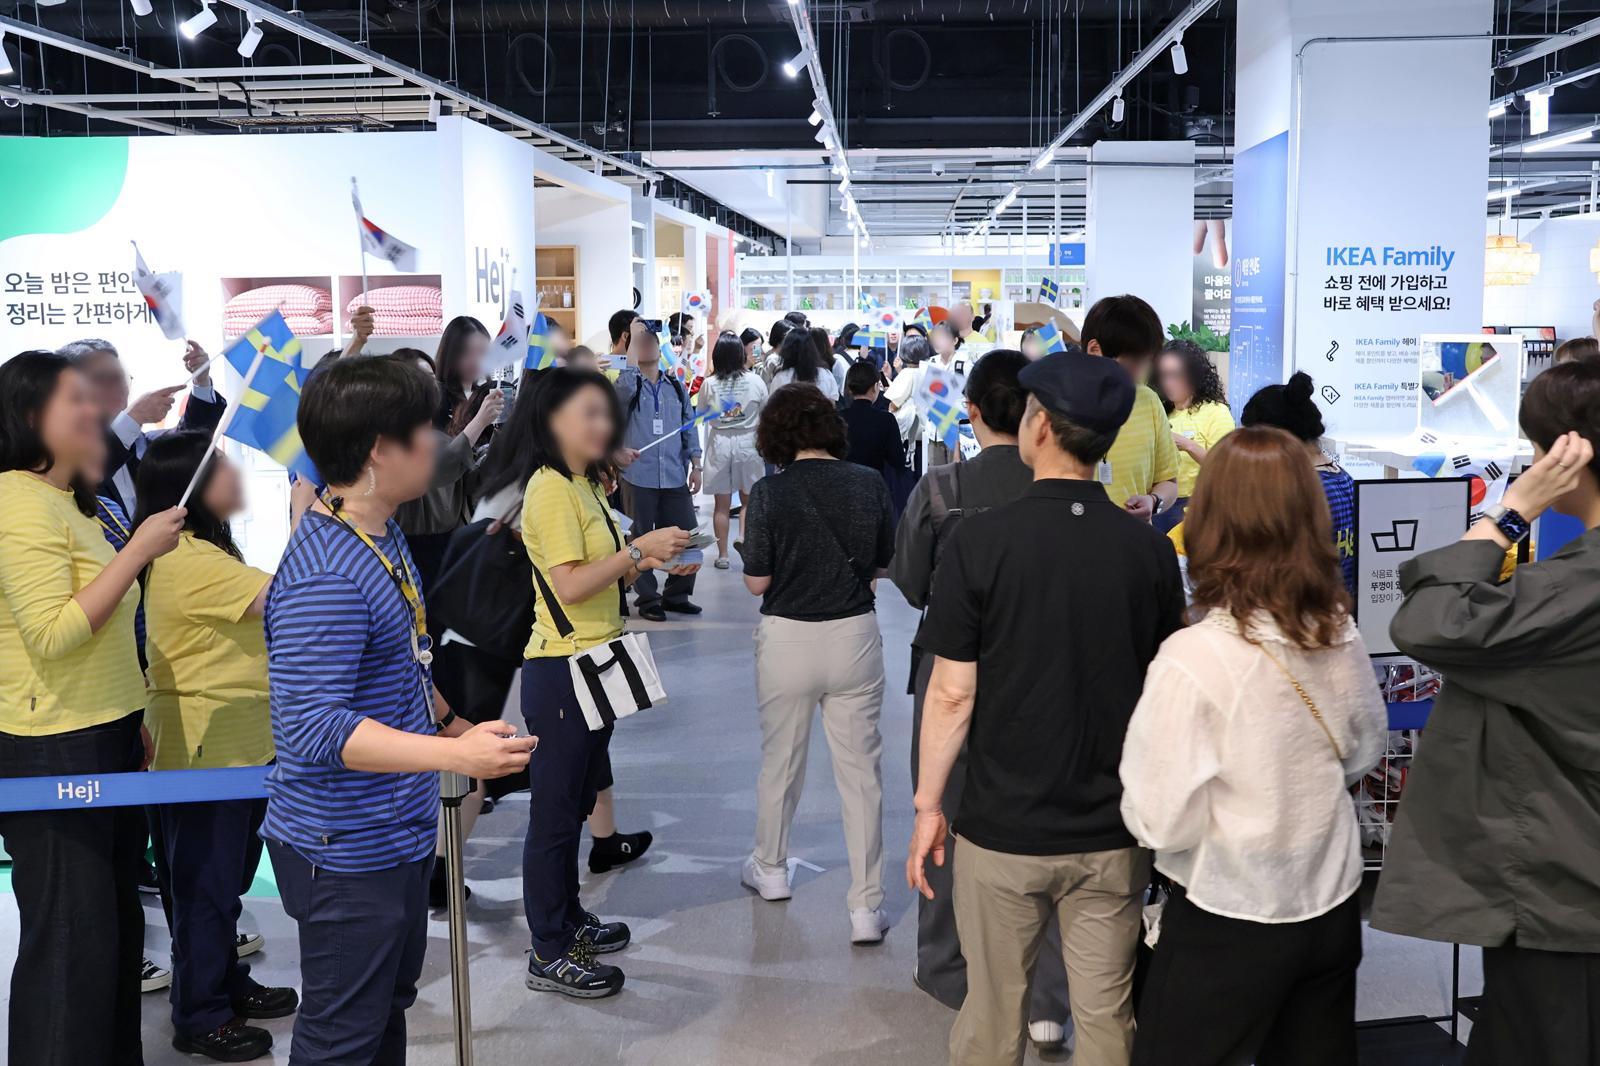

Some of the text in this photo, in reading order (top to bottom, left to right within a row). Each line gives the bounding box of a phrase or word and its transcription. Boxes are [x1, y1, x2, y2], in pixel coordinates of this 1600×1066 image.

[1326, 246, 1455, 271] IKEA Family
[5, 271, 137, 294] 오늘 밤은 편안
[1324, 275, 1448, 291] 쇼핑 전에 가입하고
[1323, 296, 1451, 311] 바로 혜택 받으세요!
[6, 302, 152, 325] 정리는 간편하게
[1355, 337, 1417, 347] IKEA Family 헤이
[1373, 383, 1399, 391] Family
[1371, 569, 1393, 579] 식음료
[1371, 581, 1394, 591] 뚜껑이
[1371, 593, 1394, 604] 입장이
[57, 780, 100, 803] Hej!
